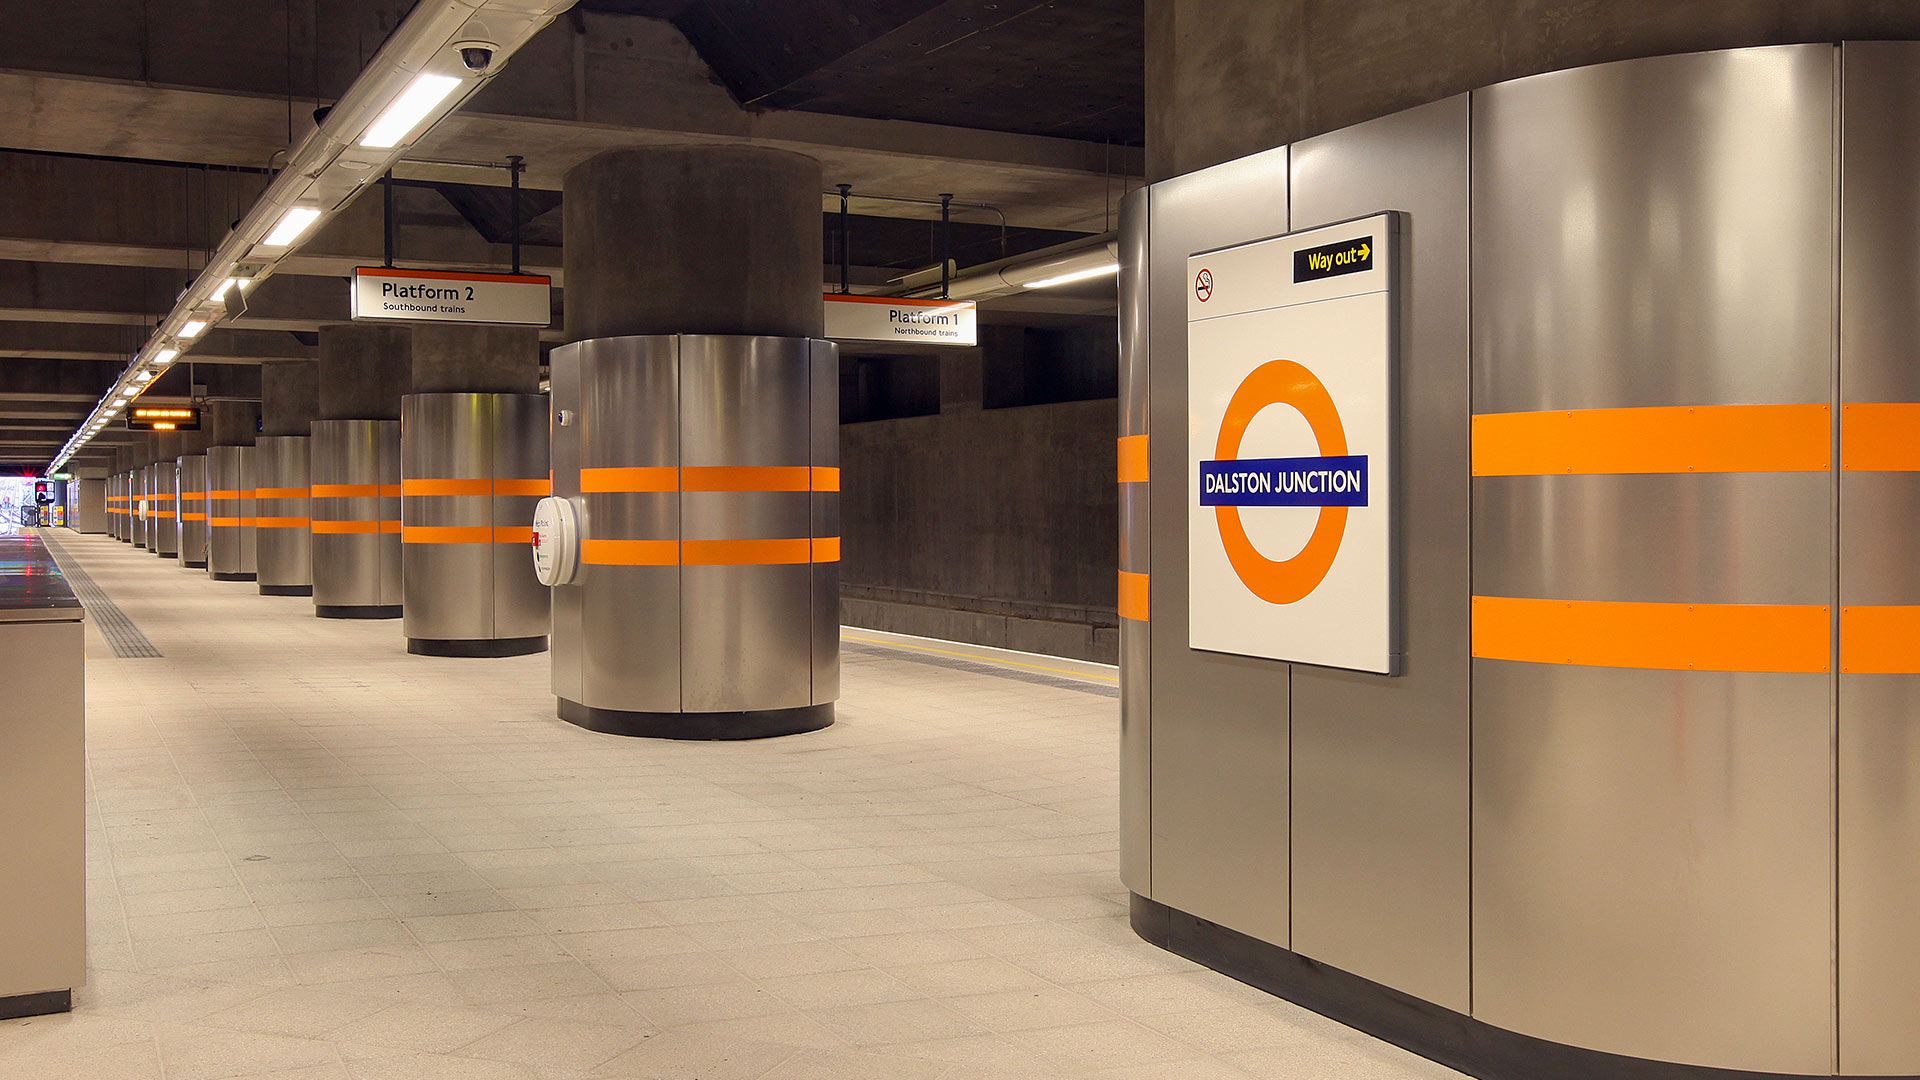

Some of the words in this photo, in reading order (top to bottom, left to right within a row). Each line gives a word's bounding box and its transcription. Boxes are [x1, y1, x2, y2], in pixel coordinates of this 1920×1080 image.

[1308, 253, 1333, 271] Way
[1335, 248, 1357, 264] out
[382, 283, 459, 300] Platform
[465, 286, 474, 301] 2
[383, 302, 437, 313] Southbound
[440, 304, 465, 314] trains
[889, 310, 948, 325] Platform
[953, 313, 958, 326] 1
[894, 327, 937, 336] Northbound
[938, 330, 958, 338] trains
[1205, 472, 1271, 494] DALSTON
[1274, 470, 1361, 494] JUNCTION
